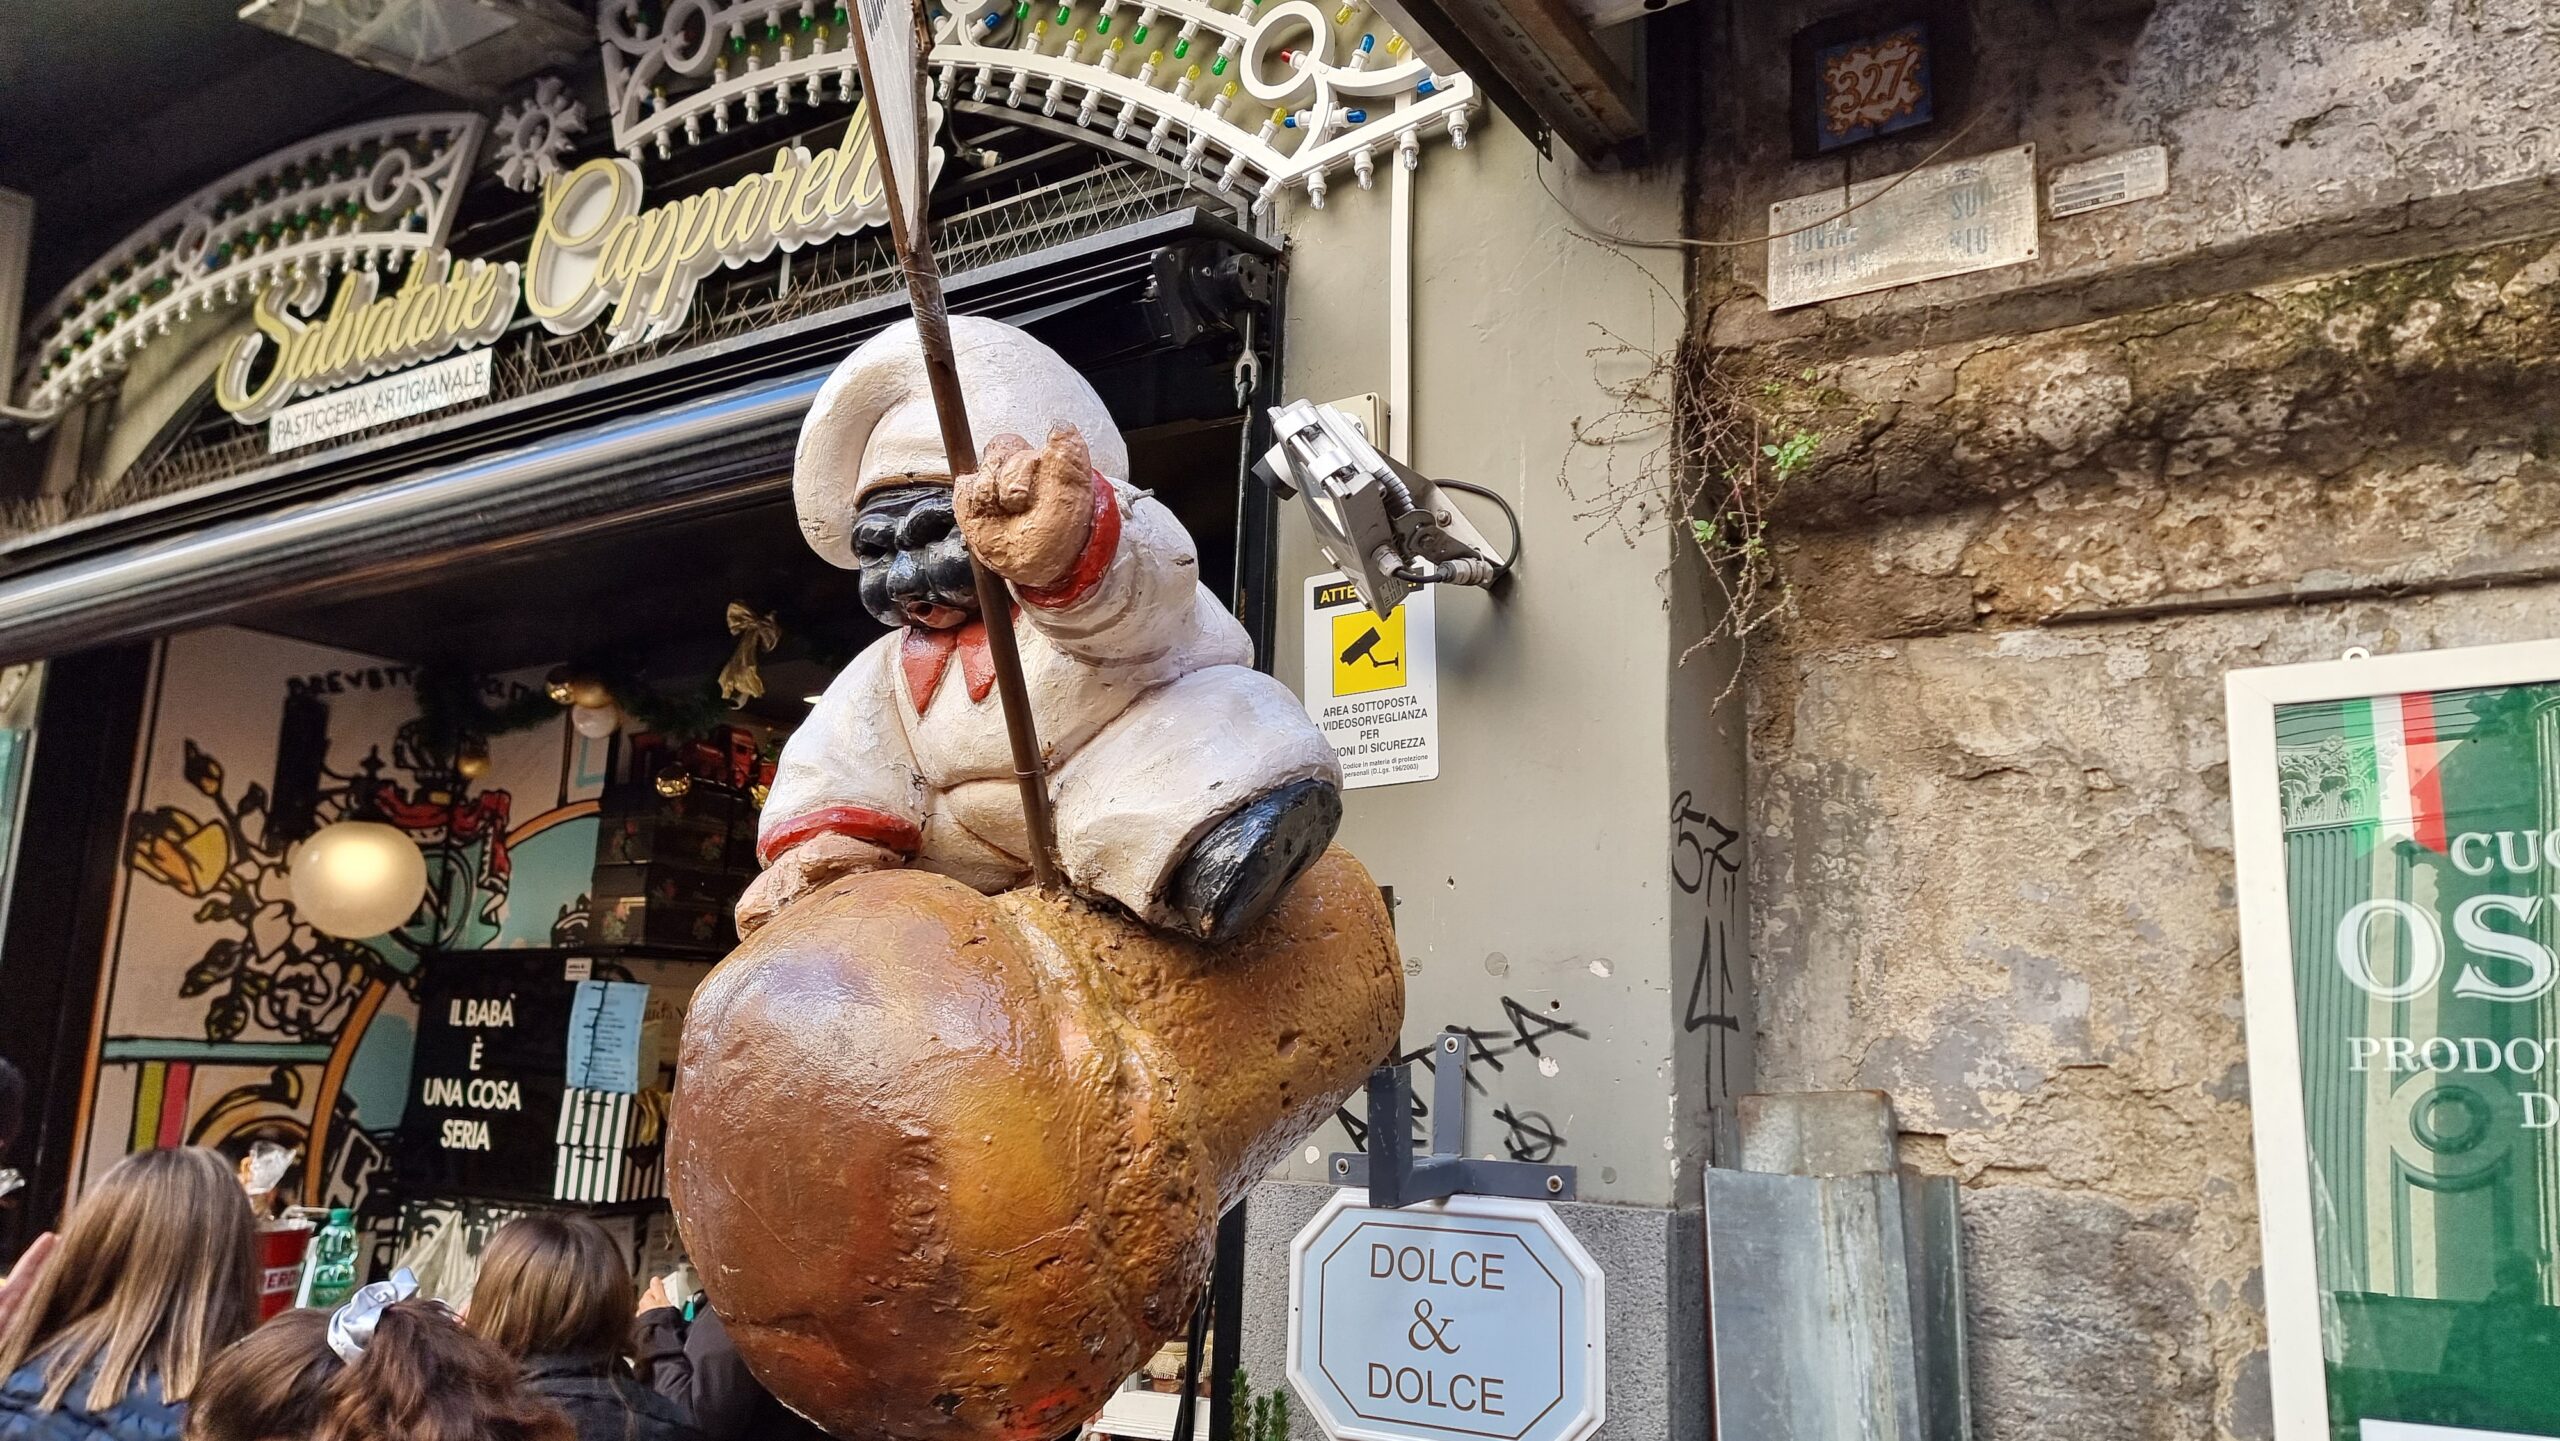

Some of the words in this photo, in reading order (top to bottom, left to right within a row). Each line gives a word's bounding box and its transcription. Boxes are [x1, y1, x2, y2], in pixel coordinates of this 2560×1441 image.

[1838, 53, 1912, 114] 327
[216, 249, 501, 413] Salvatore
[526, 97, 887, 334] Capparell
[276, 397, 368, 438] PASTICCERIA
[373, 361, 484, 411] ARTIGIANALE
[1320, 584, 1358, 604] ATTE
[1323, 704, 1349, 718] AREA
[1352, 695, 1418, 713] SOTTOPOSTA
[1323, 708, 1428, 731] VIDEOSORVEGLIANZA
[1358, 744, 1368, 755] DI
[1370, 736, 1426, 753] SICUREZZA
[1360, 728, 1379, 740] PER
[1344, 769, 1370, 779] personali
[1369, 758, 1390, 767] materia
[1398, 754, 1429, 764] protezione
[2337, 894, 2560, 1002] OS
[449, 999, 462, 1027] IL
[469, 1035, 484, 1071] È
[423, 1077, 465, 1108] UNA
[467, 1078, 522, 1111] COSA
[440, 1119, 491, 1151] SERIA
[1370, 1243, 1505, 1291] DOLCE
[1408, 1298, 1461, 1354] &
[1368, 1362, 1505, 1416] DOLCE
